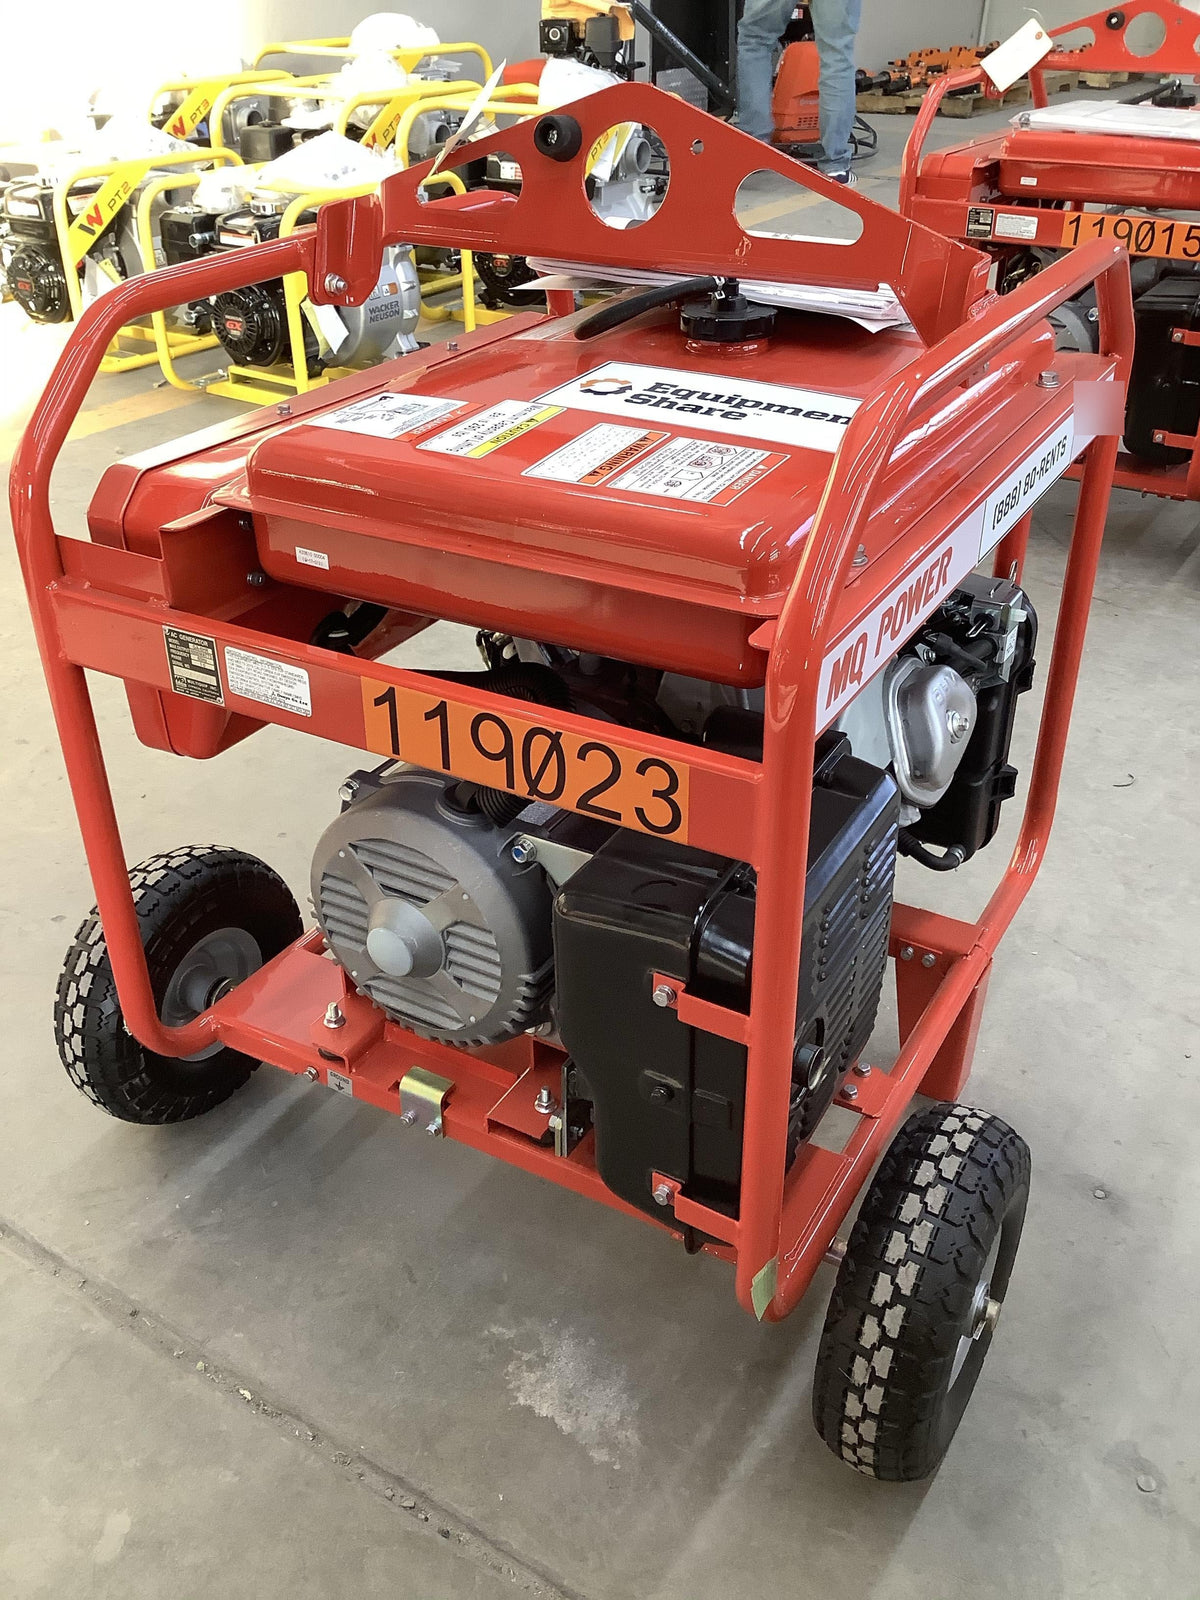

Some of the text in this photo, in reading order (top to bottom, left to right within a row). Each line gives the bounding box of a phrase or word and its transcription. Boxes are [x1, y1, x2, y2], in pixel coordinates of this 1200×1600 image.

[190, 98, 210, 124] PT3
[107, 181, 131, 212] PT2
[368, 300, 400, 315] WACKER
[369, 308, 400, 324] NEUSON
[225, 319, 243, 332] GX
[624, 393, 748, 421] Share
[643, 381, 853, 426] Equipmen
[489, 422, 530, 444] CAUTION
[599, 442, 643, 472] WARNING
[730, 469, 761, 491] DANGER
[992, 479, 1022, 530] (888)
[179, 632, 209, 647] GENERATOR
[825, 546, 953, 711] MQ POWER
[330, 1071, 350, 1084] GROUND
